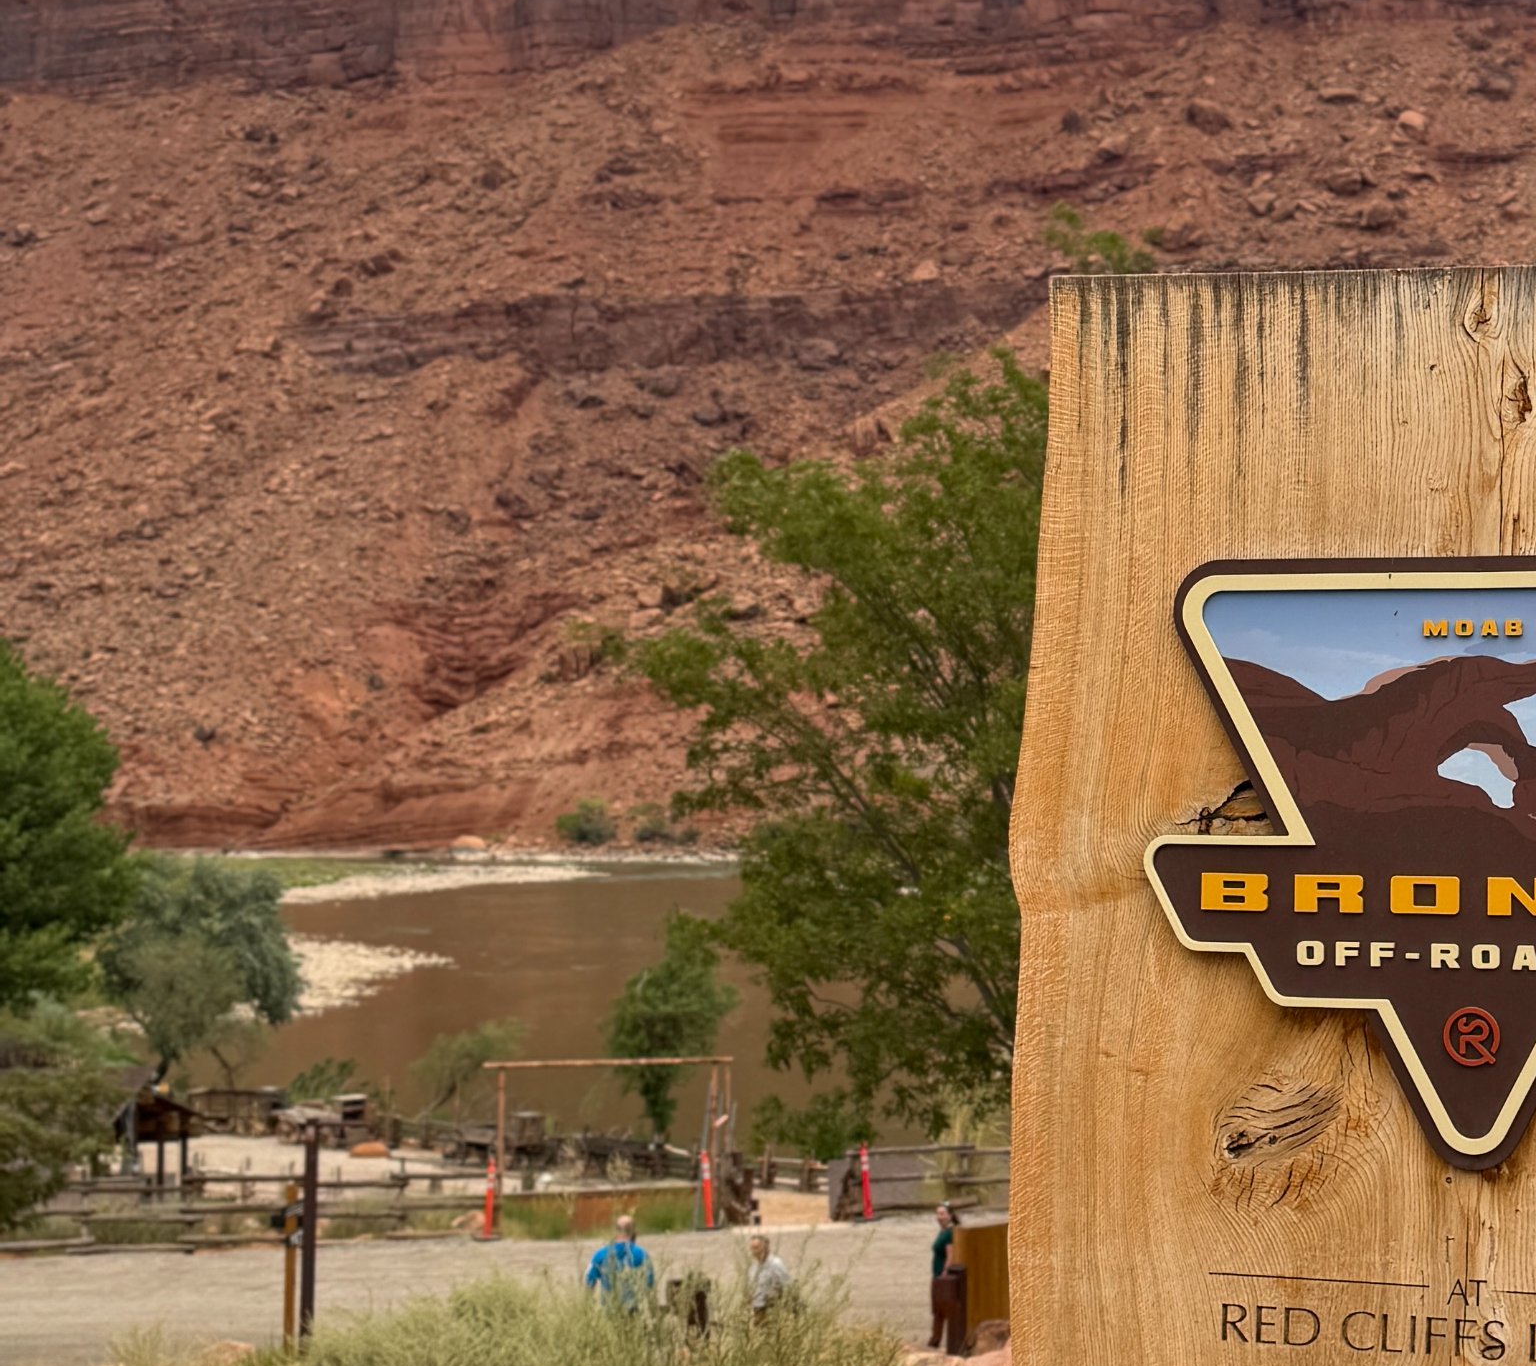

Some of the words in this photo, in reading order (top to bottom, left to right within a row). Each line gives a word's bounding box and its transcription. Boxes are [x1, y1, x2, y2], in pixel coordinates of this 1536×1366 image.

[1422, 619, 1524, 638] MOAB
[1447, 1279, 1487, 1306] AT
[1221, 1304, 1321, 1346] RED
[1341, 1311, 1506, 1360] CLIFFS
